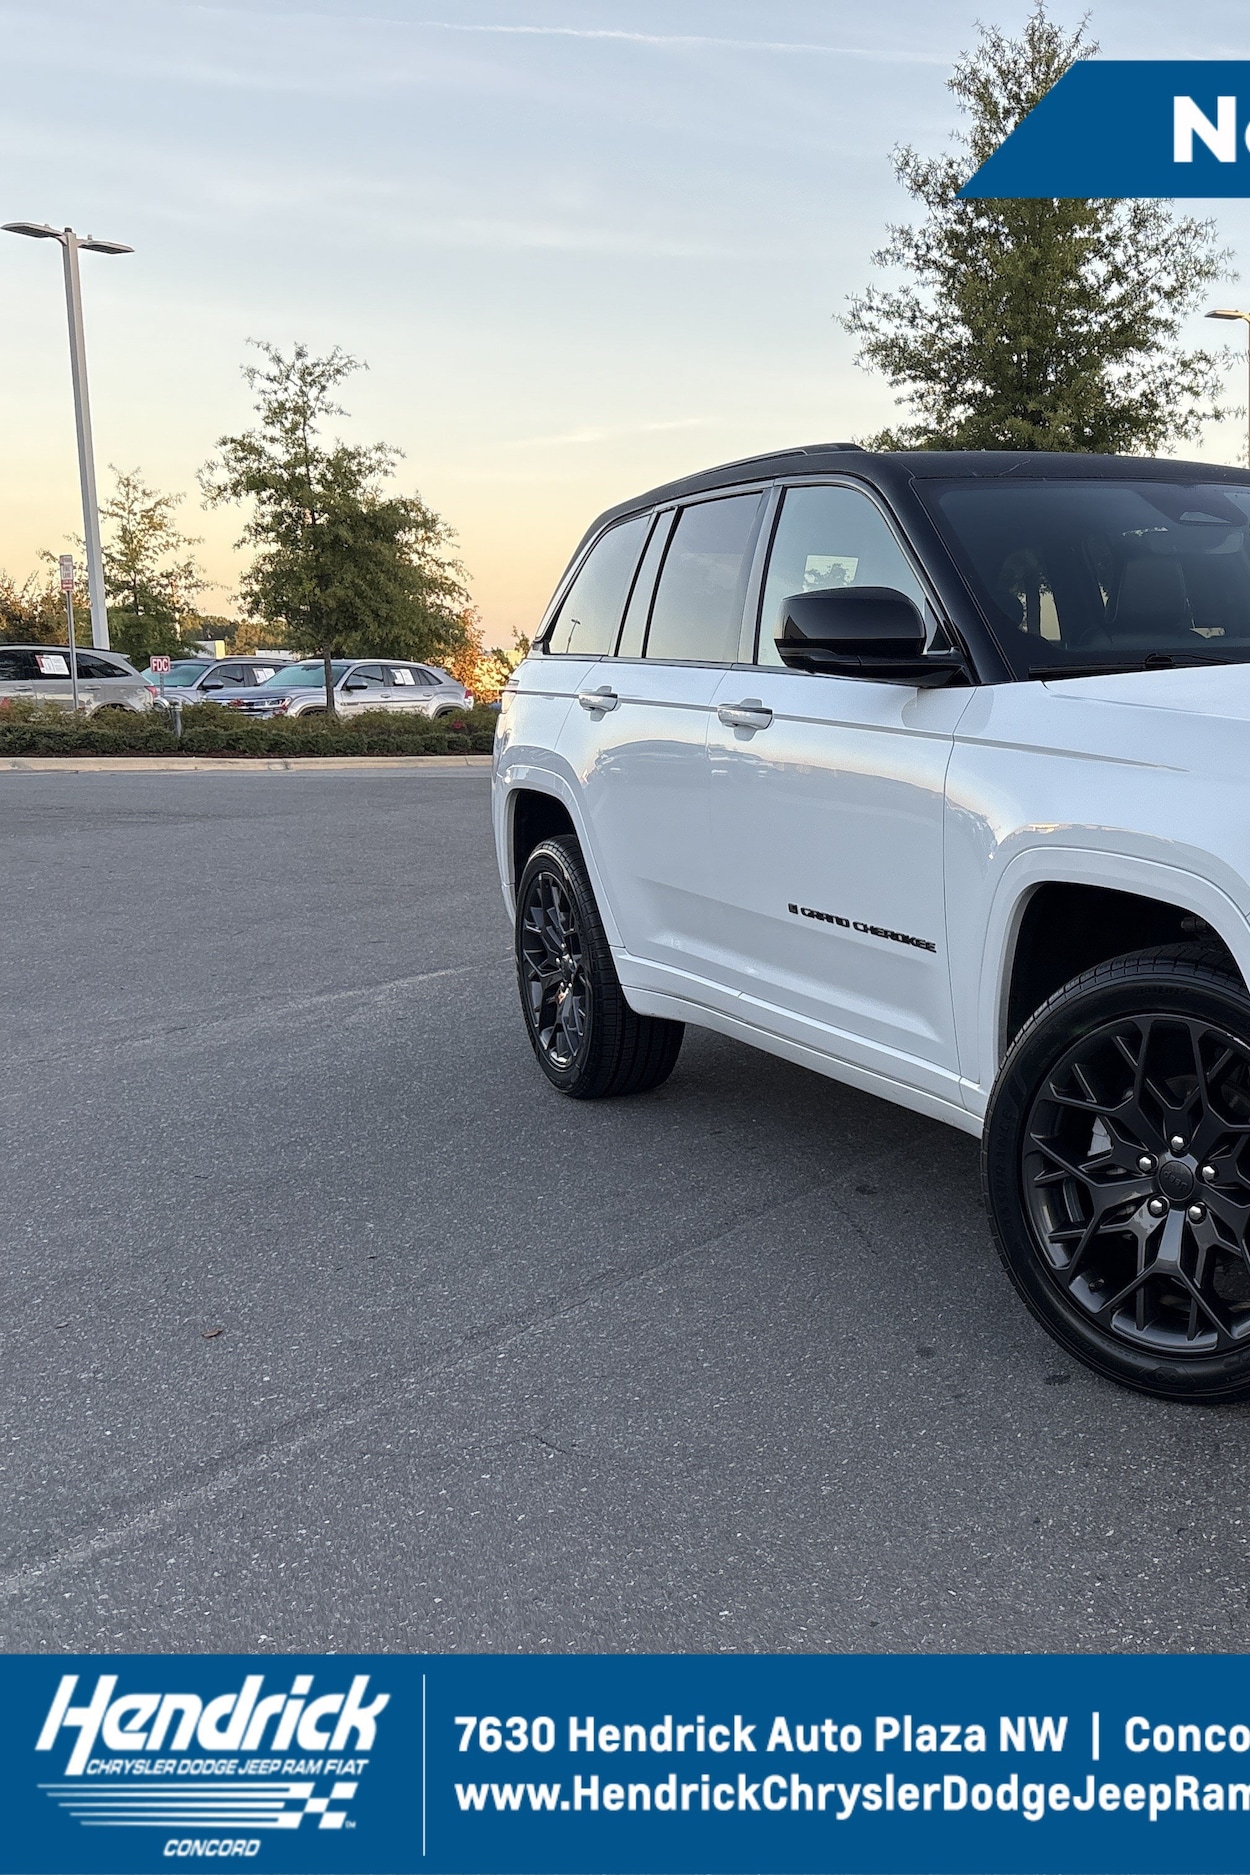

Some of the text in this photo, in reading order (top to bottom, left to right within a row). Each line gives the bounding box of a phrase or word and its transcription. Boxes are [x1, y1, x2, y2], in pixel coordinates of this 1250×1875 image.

[152, 658, 168, 671] FDC
[800, 906, 938, 954] GRAND CHEROKEE
